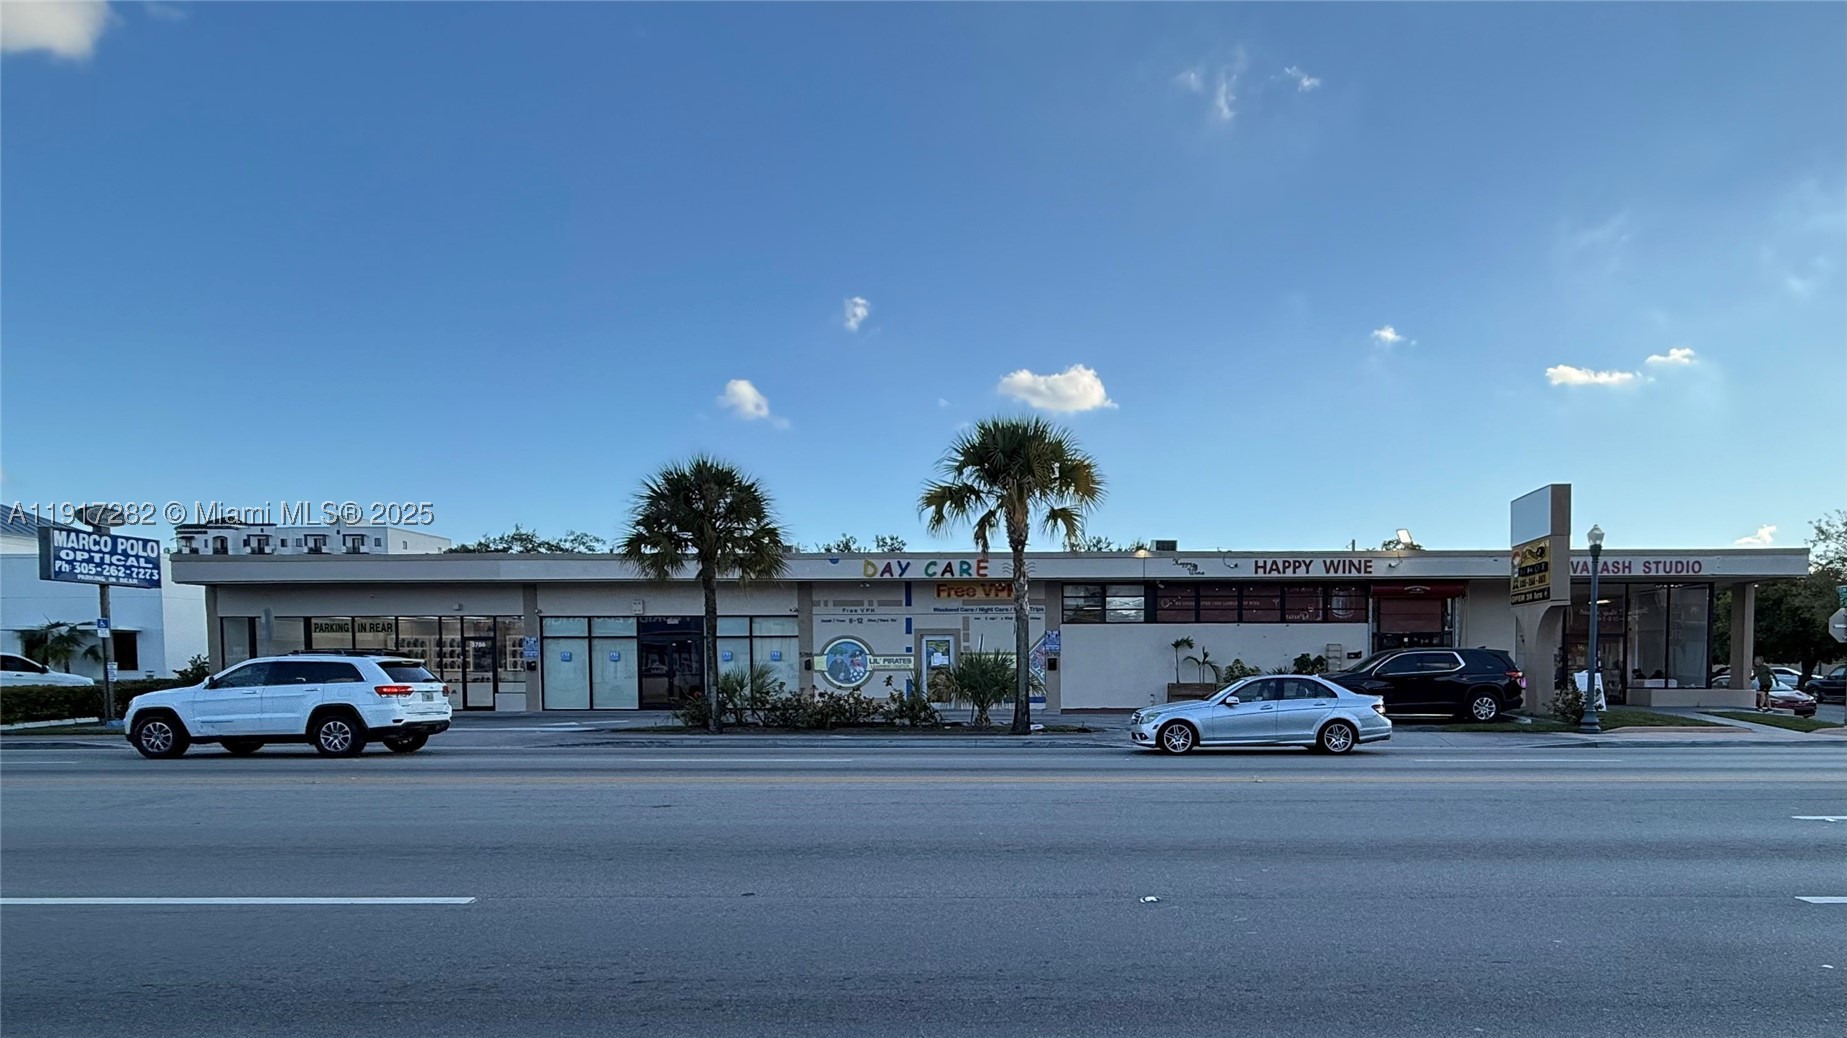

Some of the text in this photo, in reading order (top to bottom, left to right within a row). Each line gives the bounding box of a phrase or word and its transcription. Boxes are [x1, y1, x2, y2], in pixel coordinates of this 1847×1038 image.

[53, 530, 158, 558] MARCO POLO
[59, 549, 153, 568] OPTICAL
[73, 562, 159, 580] 305-262-7273
[863, 559, 989, 577] DAY CARE
[1254, 560, 1373, 574] HAPPY WINE
[1570, 560, 1702, 574] VAASH STUDIO
[77, 574, 106, 582] PARKING
[936, 583, 976, 598] Free
[313, 622, 393, 633] PARKING IN REAR
